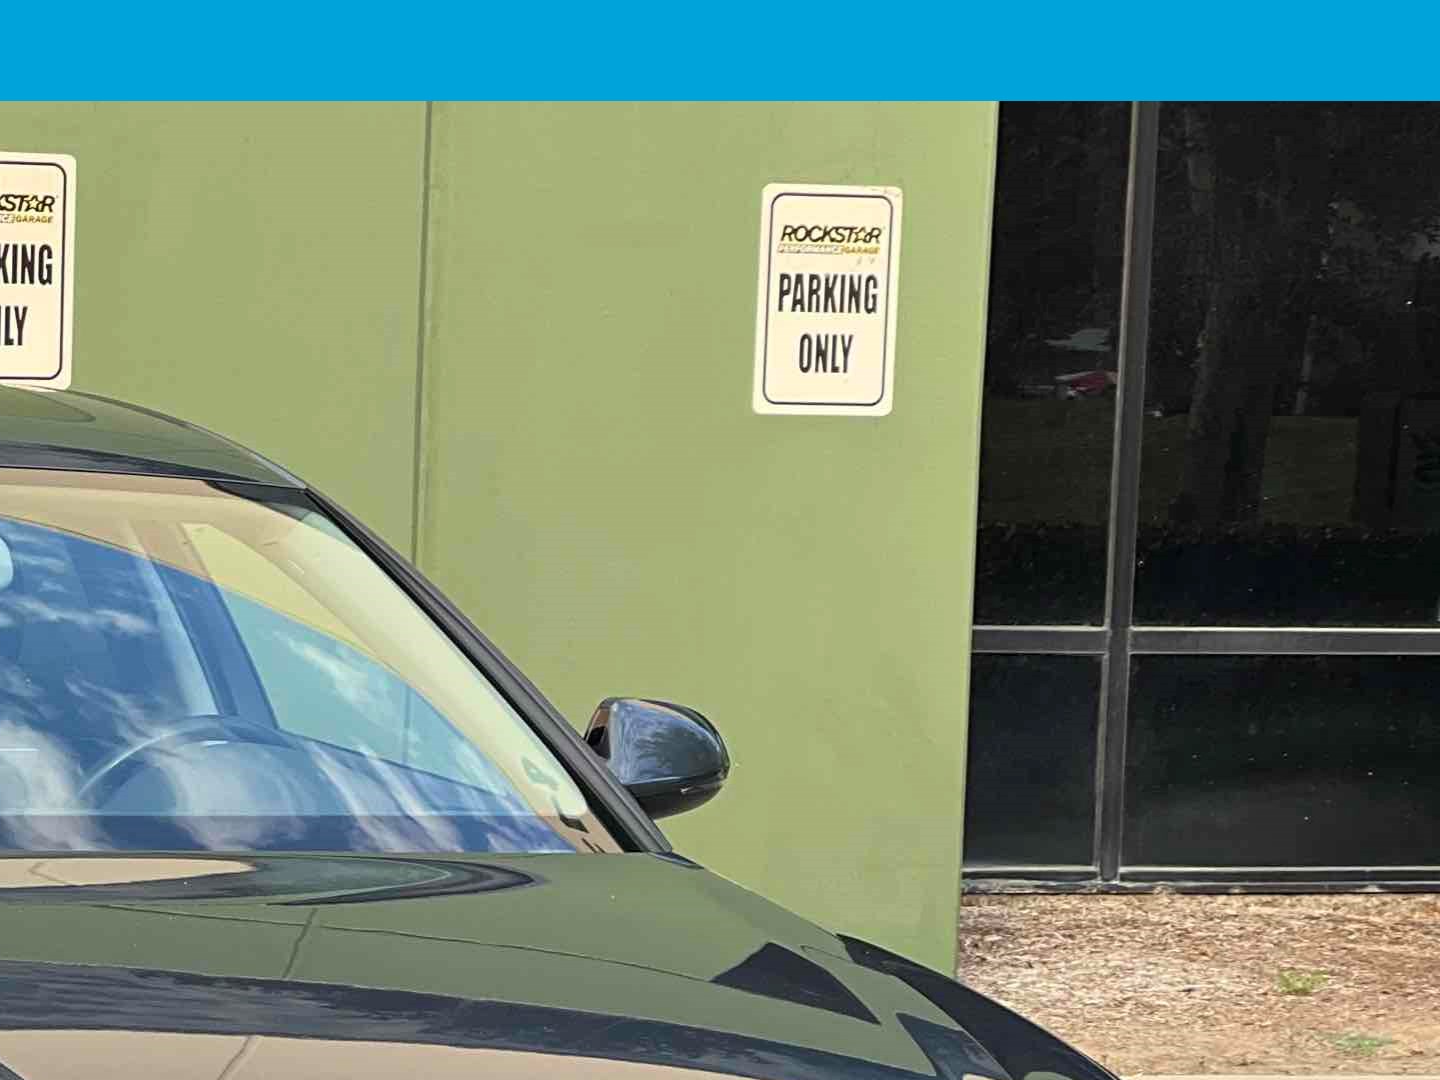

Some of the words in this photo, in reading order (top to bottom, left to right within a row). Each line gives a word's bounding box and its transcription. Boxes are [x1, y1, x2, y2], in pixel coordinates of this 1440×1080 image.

[15, 215, 53, 224] GARAGE
[777, 272, 878, 314] PARKING
[798, 333, 853, 373] ONLY
